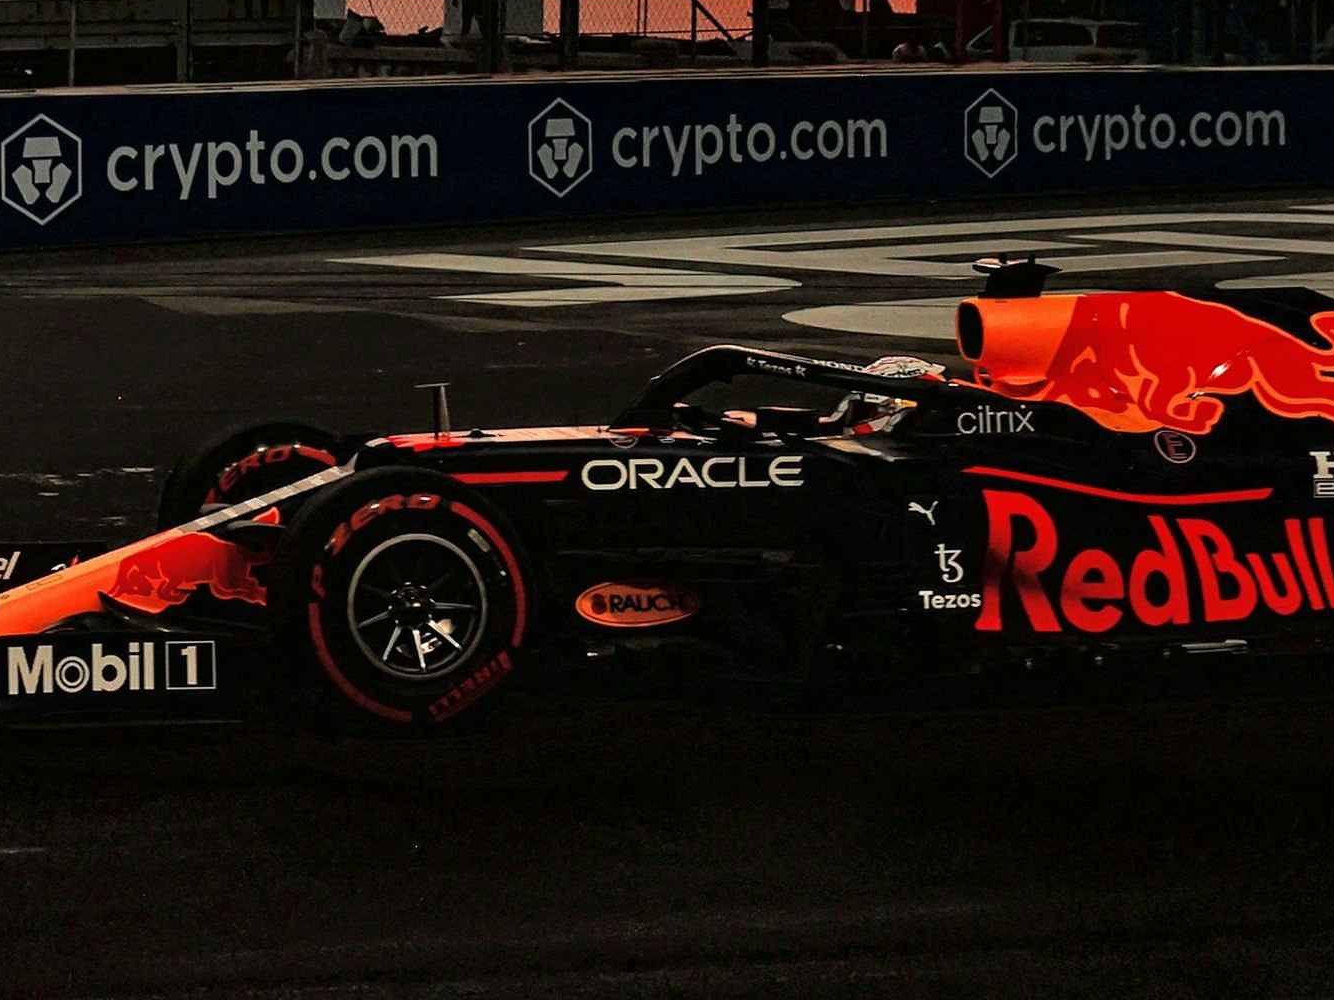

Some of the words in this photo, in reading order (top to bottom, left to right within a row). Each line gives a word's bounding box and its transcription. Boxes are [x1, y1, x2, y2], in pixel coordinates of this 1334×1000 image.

[611, 112, 889, 177] crypto.com
[1033, 103, 1287, 162] crypto.com
[106, 129, 439, 201] crypto.com
[957, 404, 1035, 434] citrix
[581, 455, 805, 491] ORACLE
[918, 590, 982, 610] Tezos
[7, 641, 156, 695] Mobil
[181, 645, 199, 686] 1
